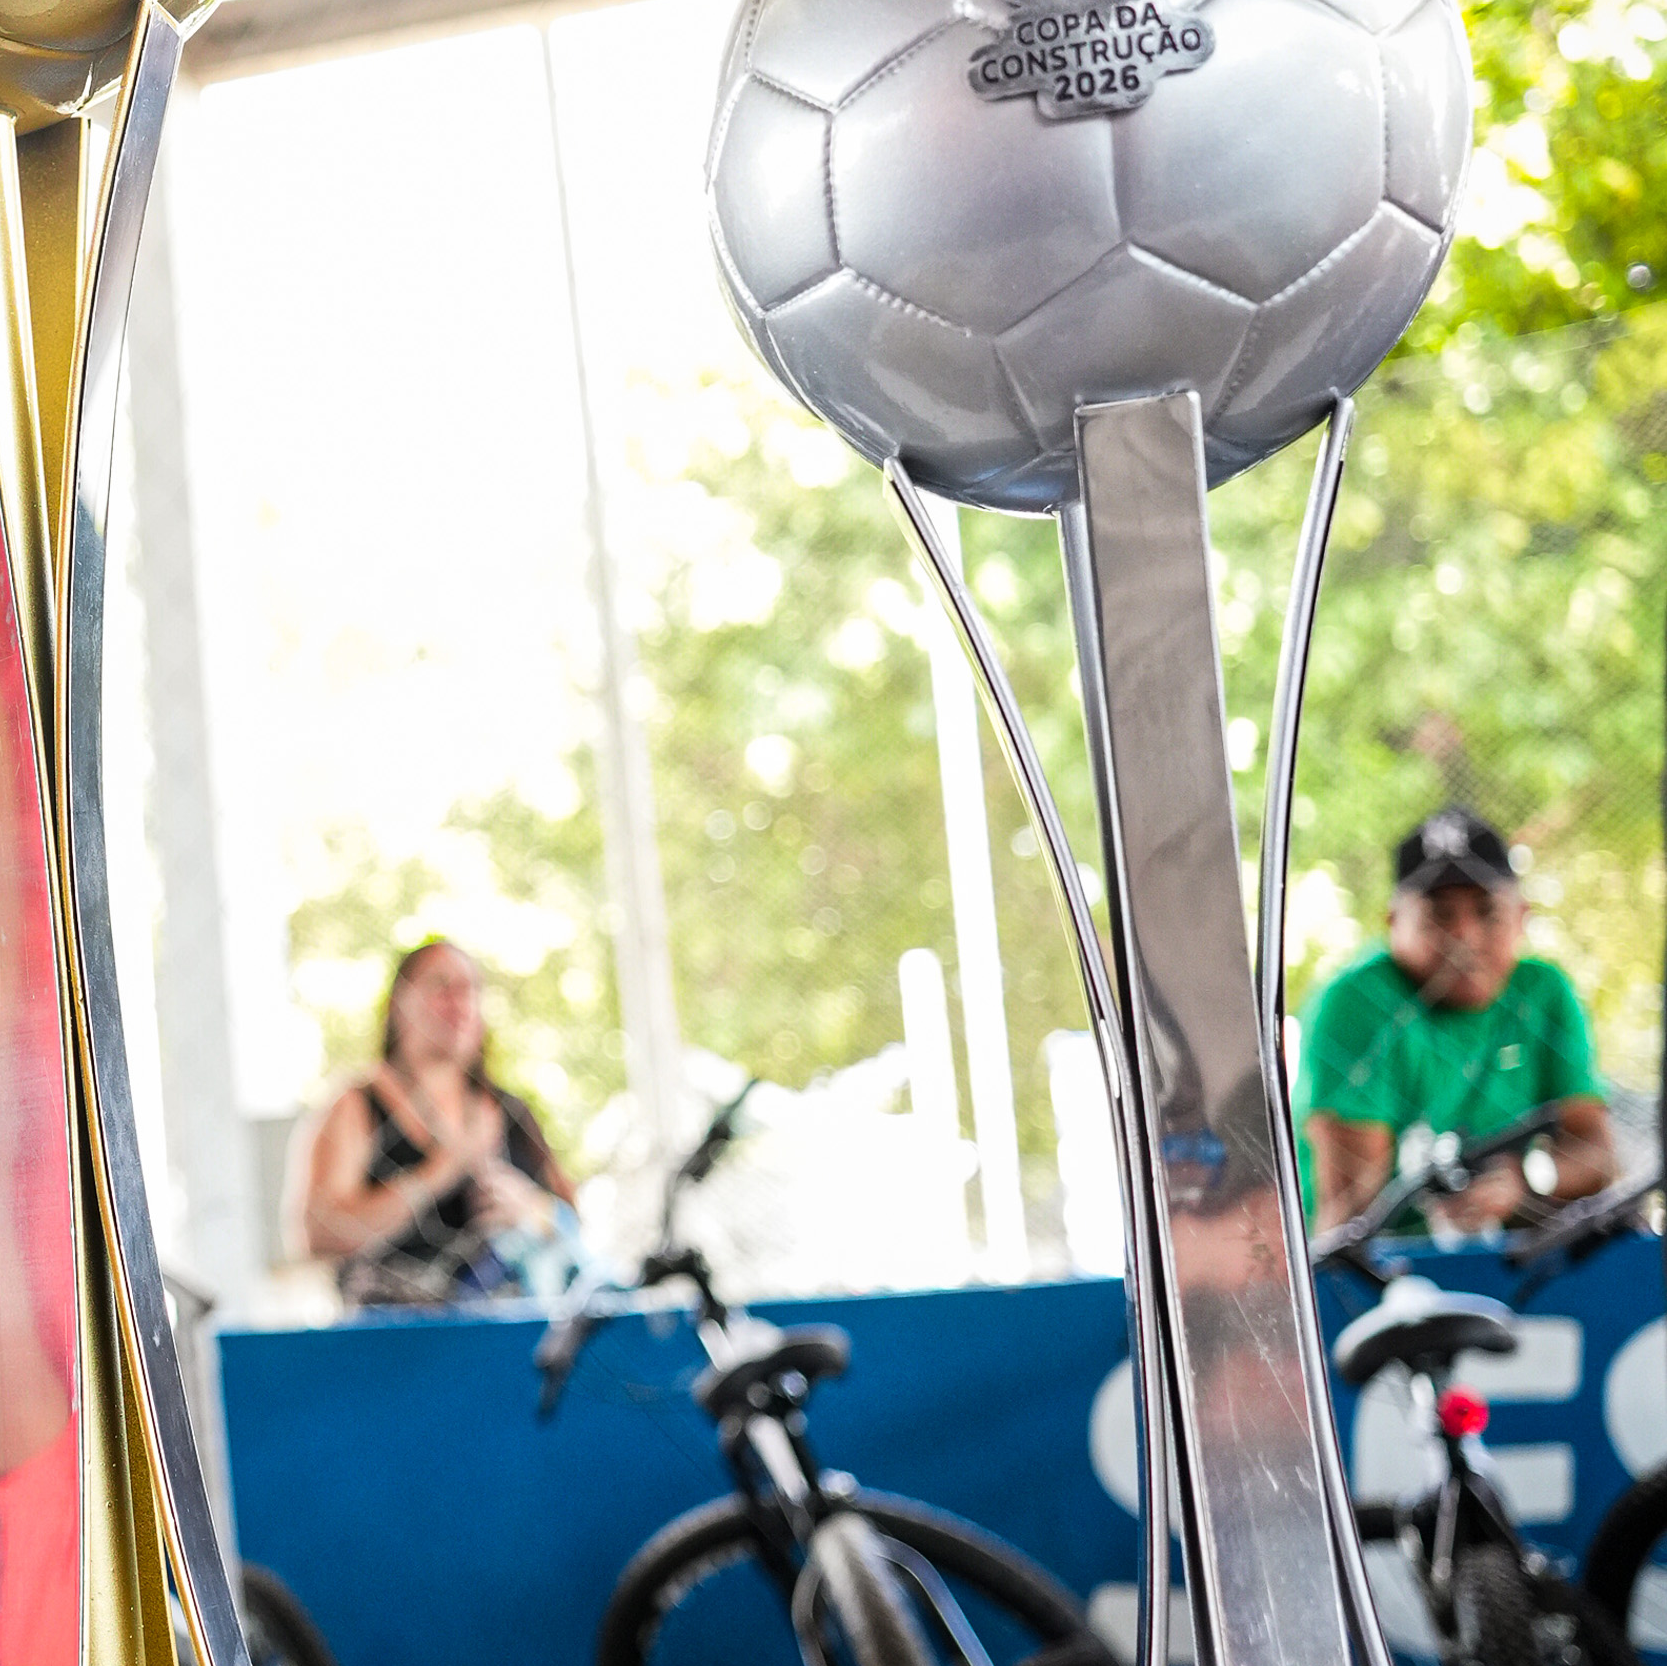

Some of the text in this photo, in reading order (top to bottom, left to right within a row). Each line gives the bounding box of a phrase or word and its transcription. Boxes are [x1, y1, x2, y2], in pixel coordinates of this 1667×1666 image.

[1016, 2, 1163, 46] COPA DA
[980, 24, 1201, 83] CONSTRUÇÃO
[1054, 66, 1140, 101] 2026
